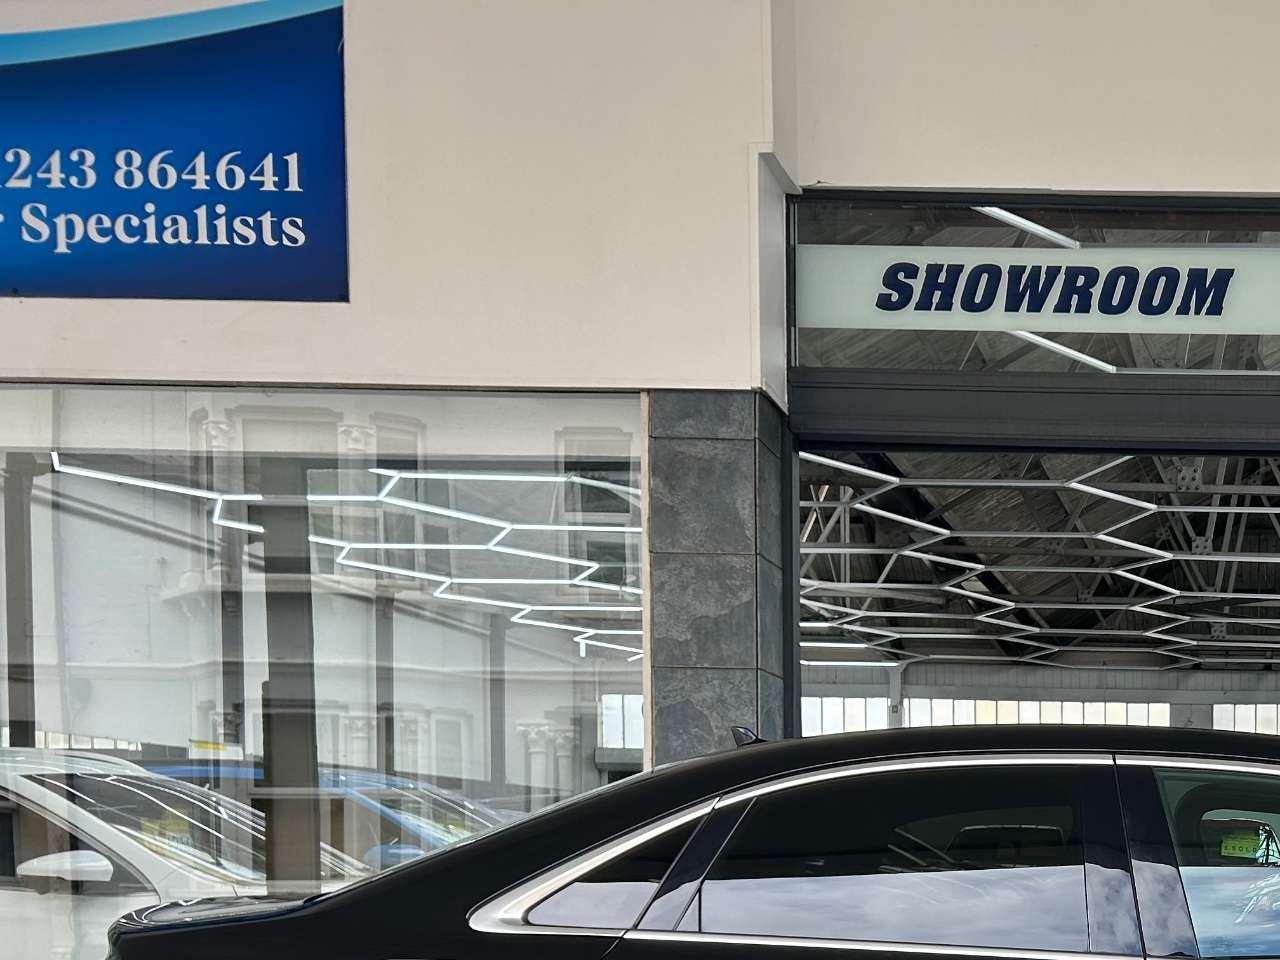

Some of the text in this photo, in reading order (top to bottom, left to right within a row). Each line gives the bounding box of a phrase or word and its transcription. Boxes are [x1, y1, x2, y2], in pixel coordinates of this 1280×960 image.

[0, 148, 304, 191] 243 864641
[20, 202, 306, 254] Specialists
[875, 261, 1236, 316] SHOWROOM
